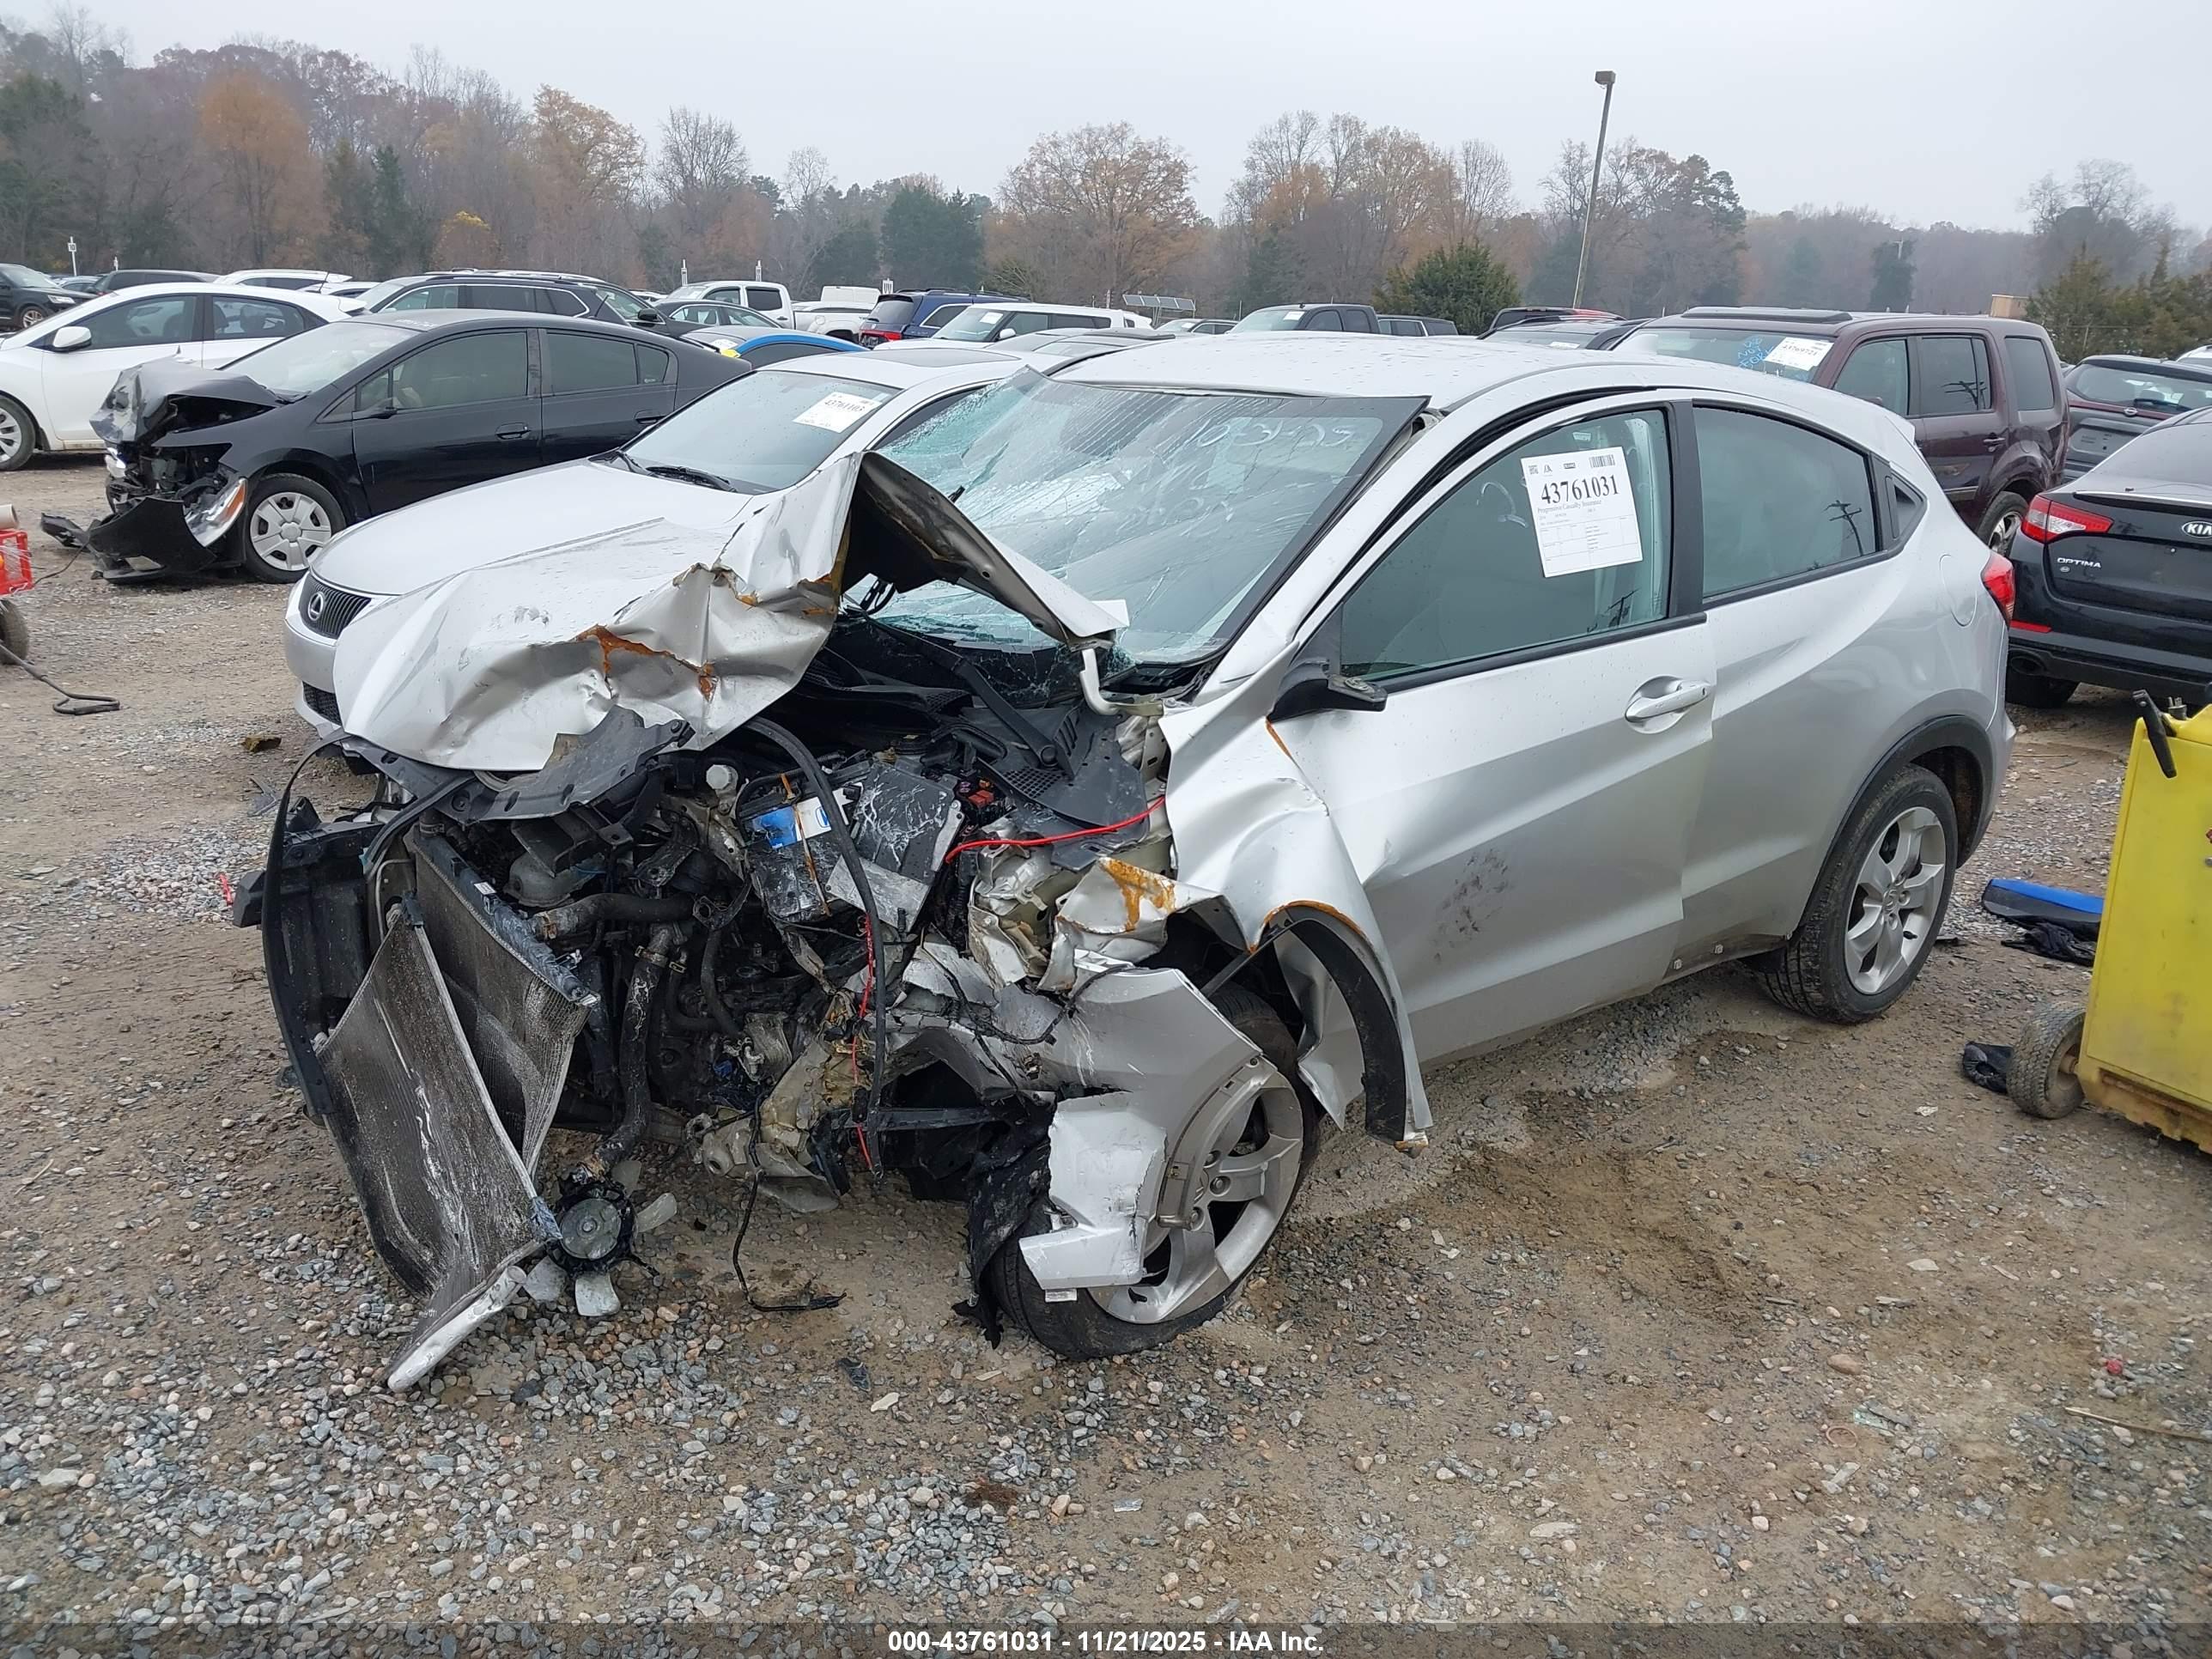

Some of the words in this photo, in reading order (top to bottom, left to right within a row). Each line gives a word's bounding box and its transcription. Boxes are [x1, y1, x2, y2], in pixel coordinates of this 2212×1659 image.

[1540, 474, 1620, 505] 43761031
[2186, 523, 2212, 536] KIA
[2057, 556, 2102, 568] OPTIMA
